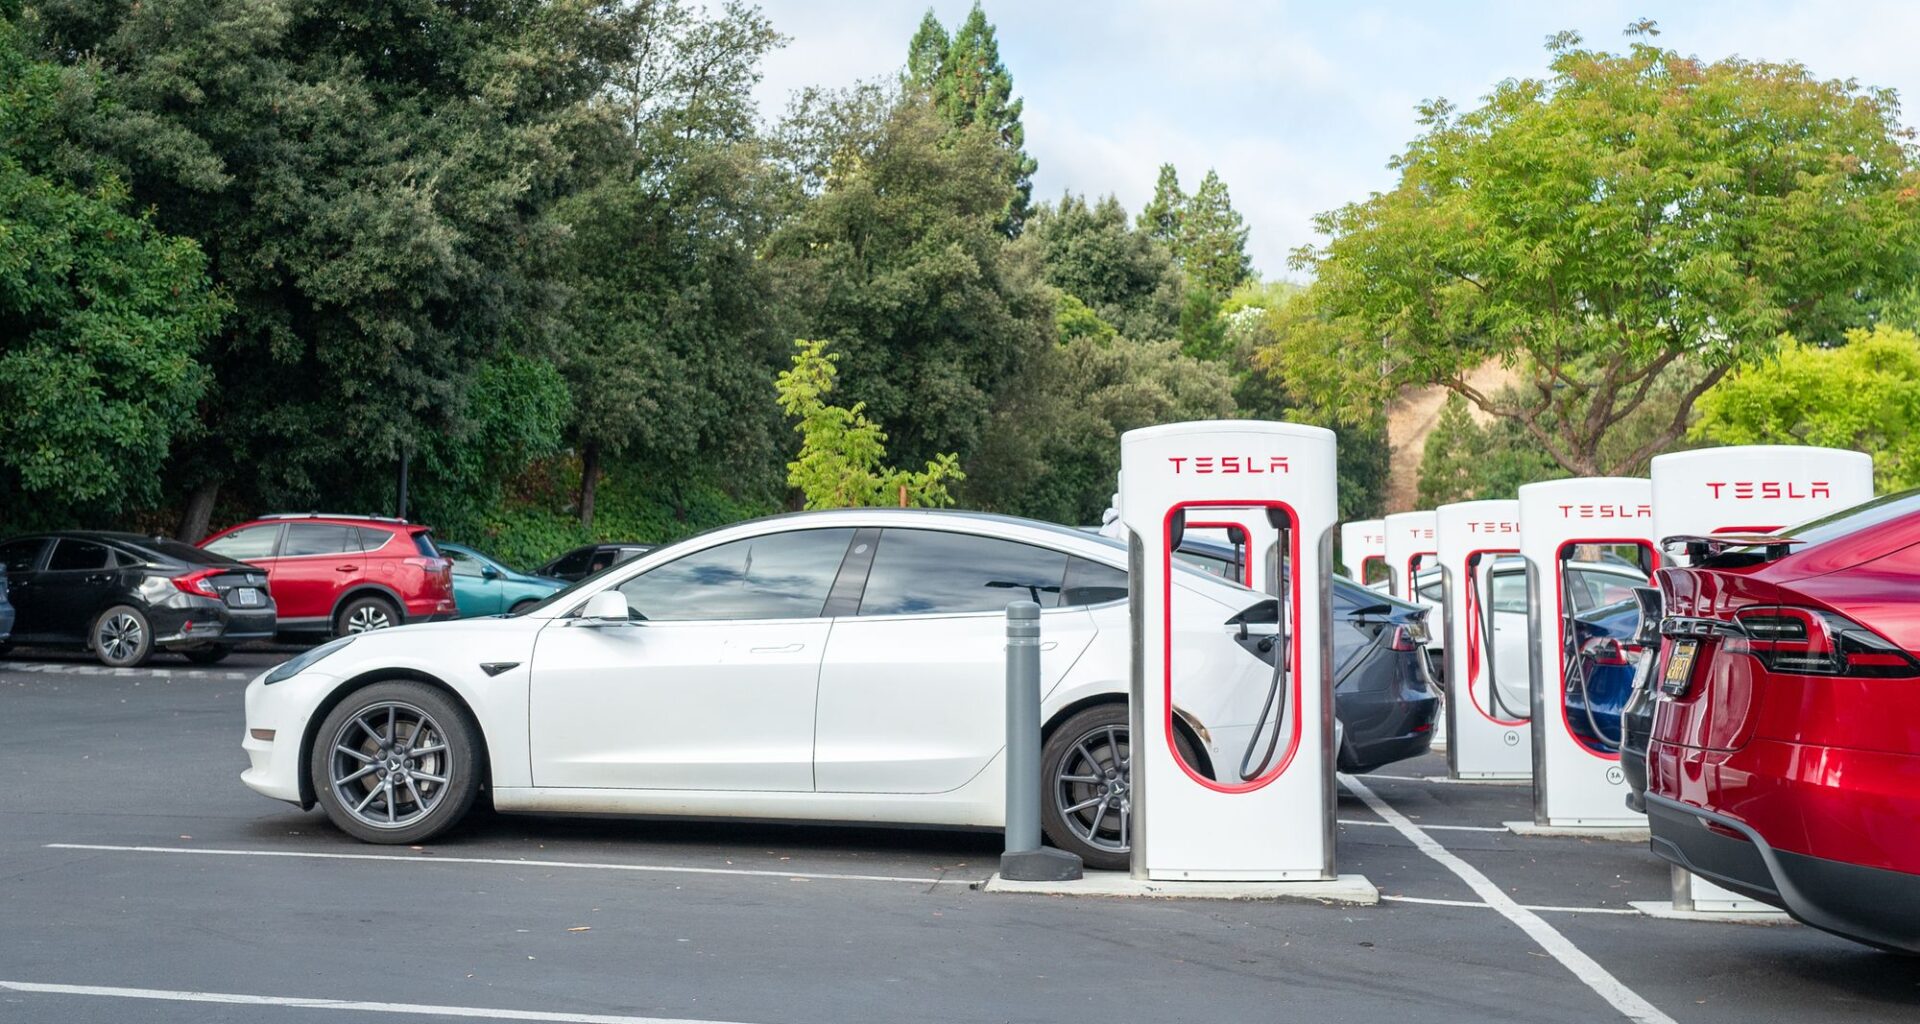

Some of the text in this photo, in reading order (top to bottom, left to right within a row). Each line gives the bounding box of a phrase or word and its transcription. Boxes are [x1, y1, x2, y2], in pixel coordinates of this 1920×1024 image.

[1168, 457, 1288, 474] TESLA
[1706, 482, 1829, 499] TESLA
[1558, 505, 1651, 518] TESLA
